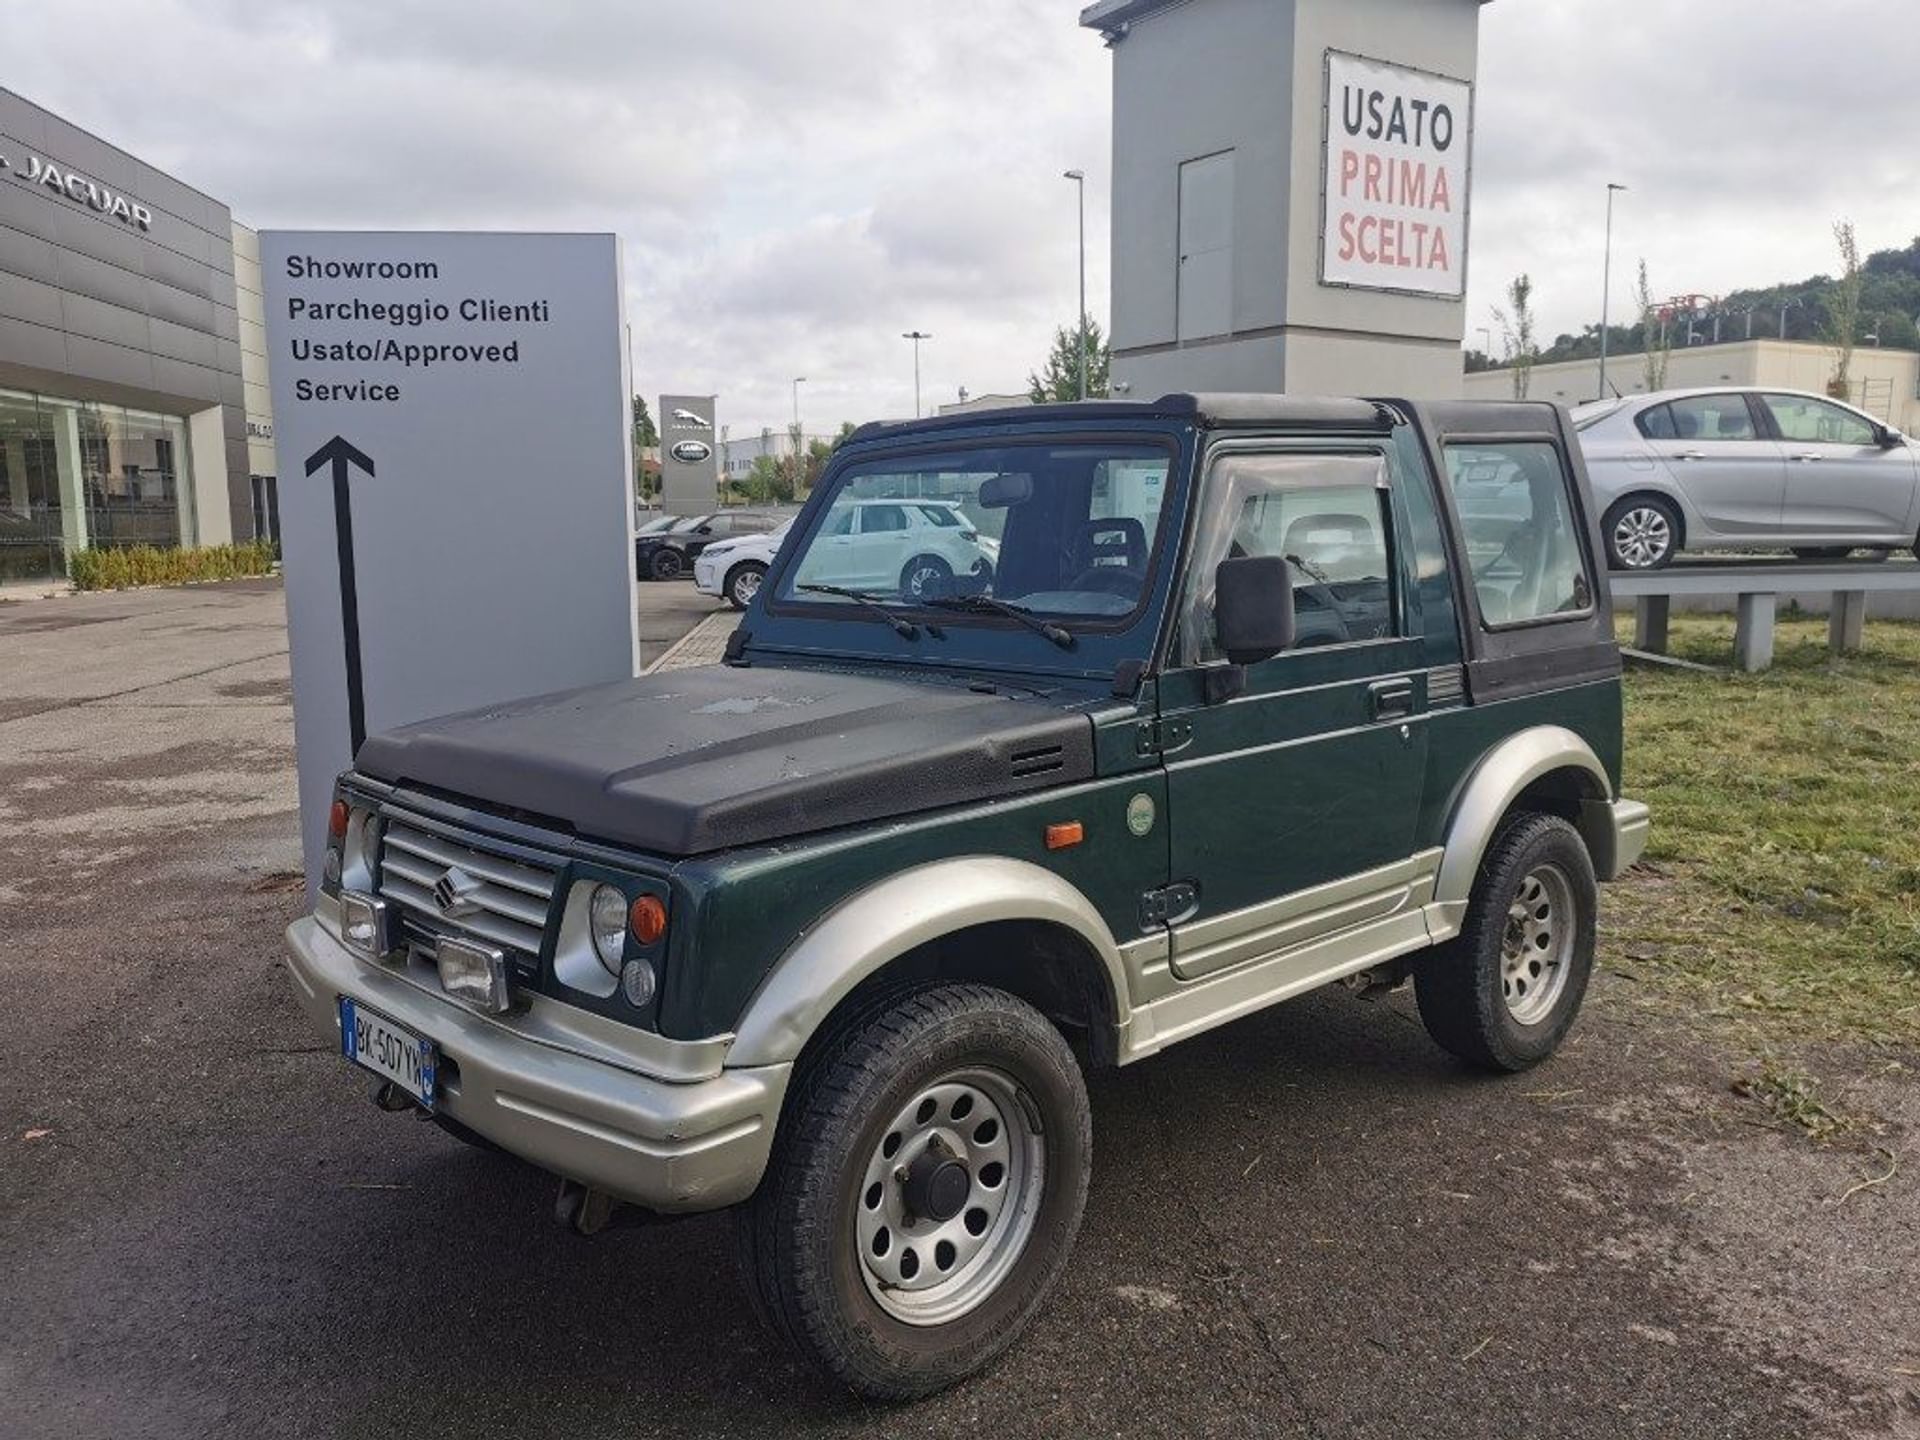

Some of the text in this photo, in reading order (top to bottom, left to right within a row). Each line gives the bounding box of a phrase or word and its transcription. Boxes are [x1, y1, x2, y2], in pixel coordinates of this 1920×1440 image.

[1343, 85, 1453, 152] USATO
[14, 156, 152, 231] JAGUAR
[1340, 149, 1450, 213] PRIMA
[1338, 211, 1449, 271] SCELTA
[286, 255, 438, 278] Showroom
[288, 298, 549, 326] Parcheggio Clienti
[292, 339, 519, 366] Usato/Approved
[295, 379, 400, 401] Service
